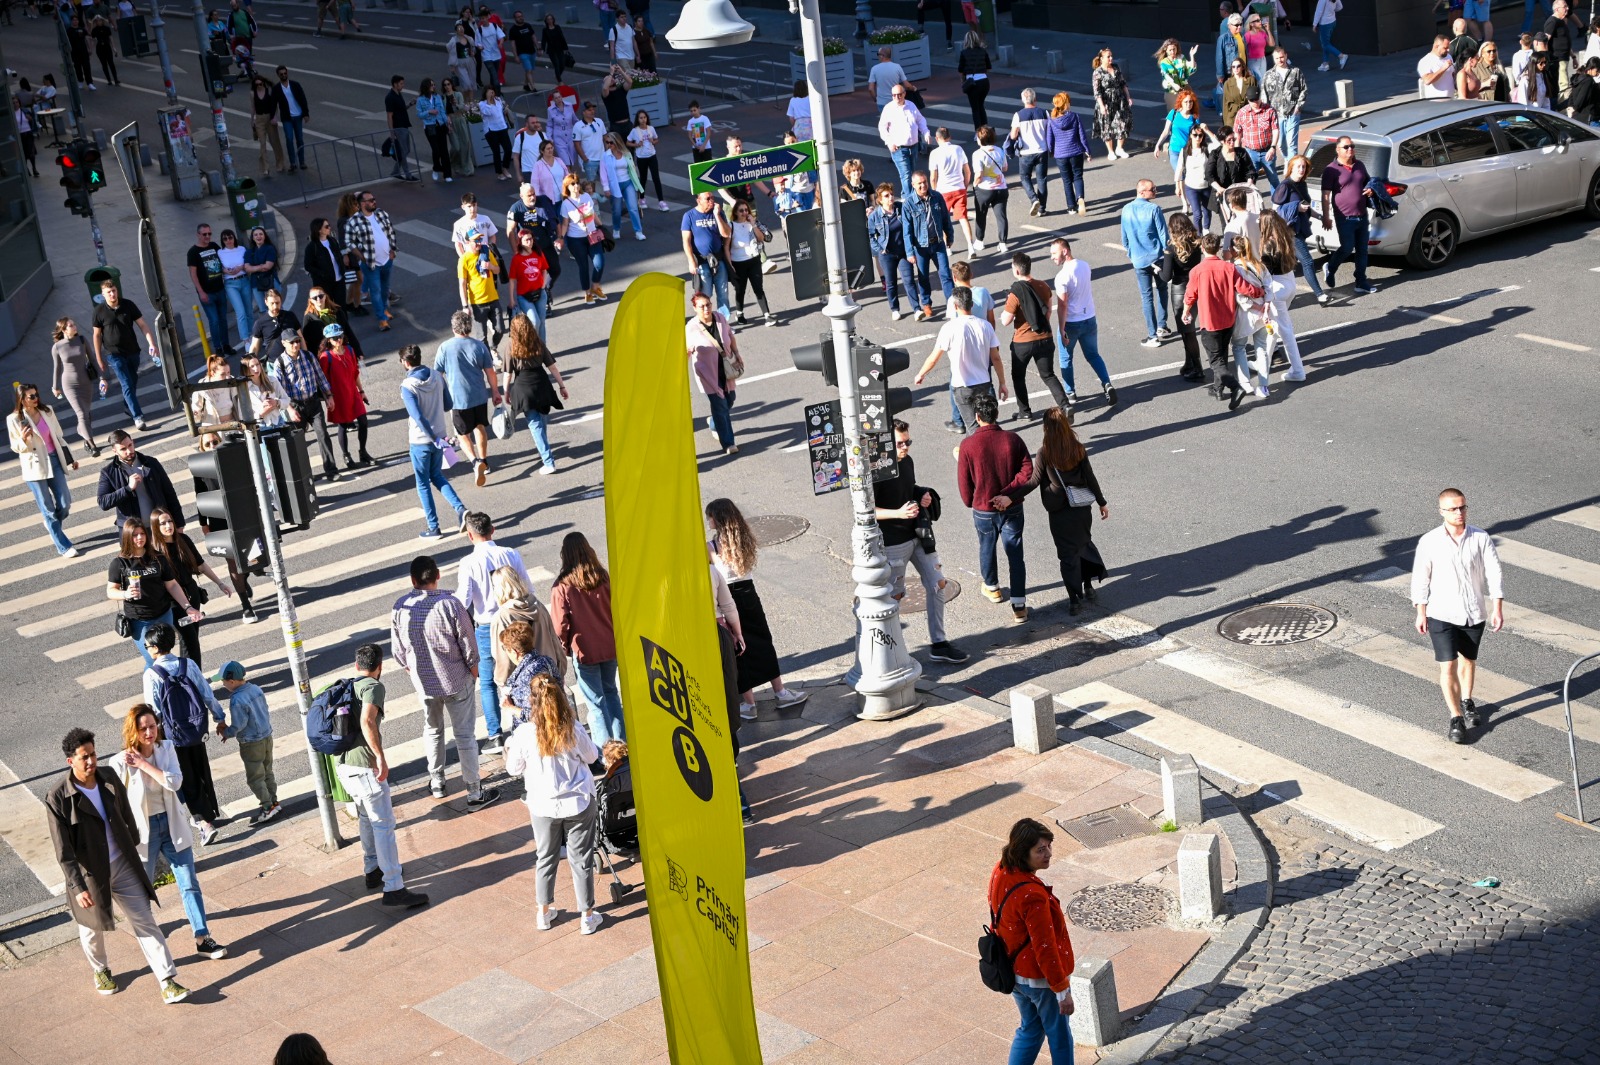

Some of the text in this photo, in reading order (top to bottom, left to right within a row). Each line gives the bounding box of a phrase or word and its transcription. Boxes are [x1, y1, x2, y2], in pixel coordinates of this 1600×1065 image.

[721, 163, 788, 184] Ion Câmpineanu
[740, 154, 767, 167] Strada
[696, 874, 739, 935] Primări
[695, 897, 738, 952] Capital
